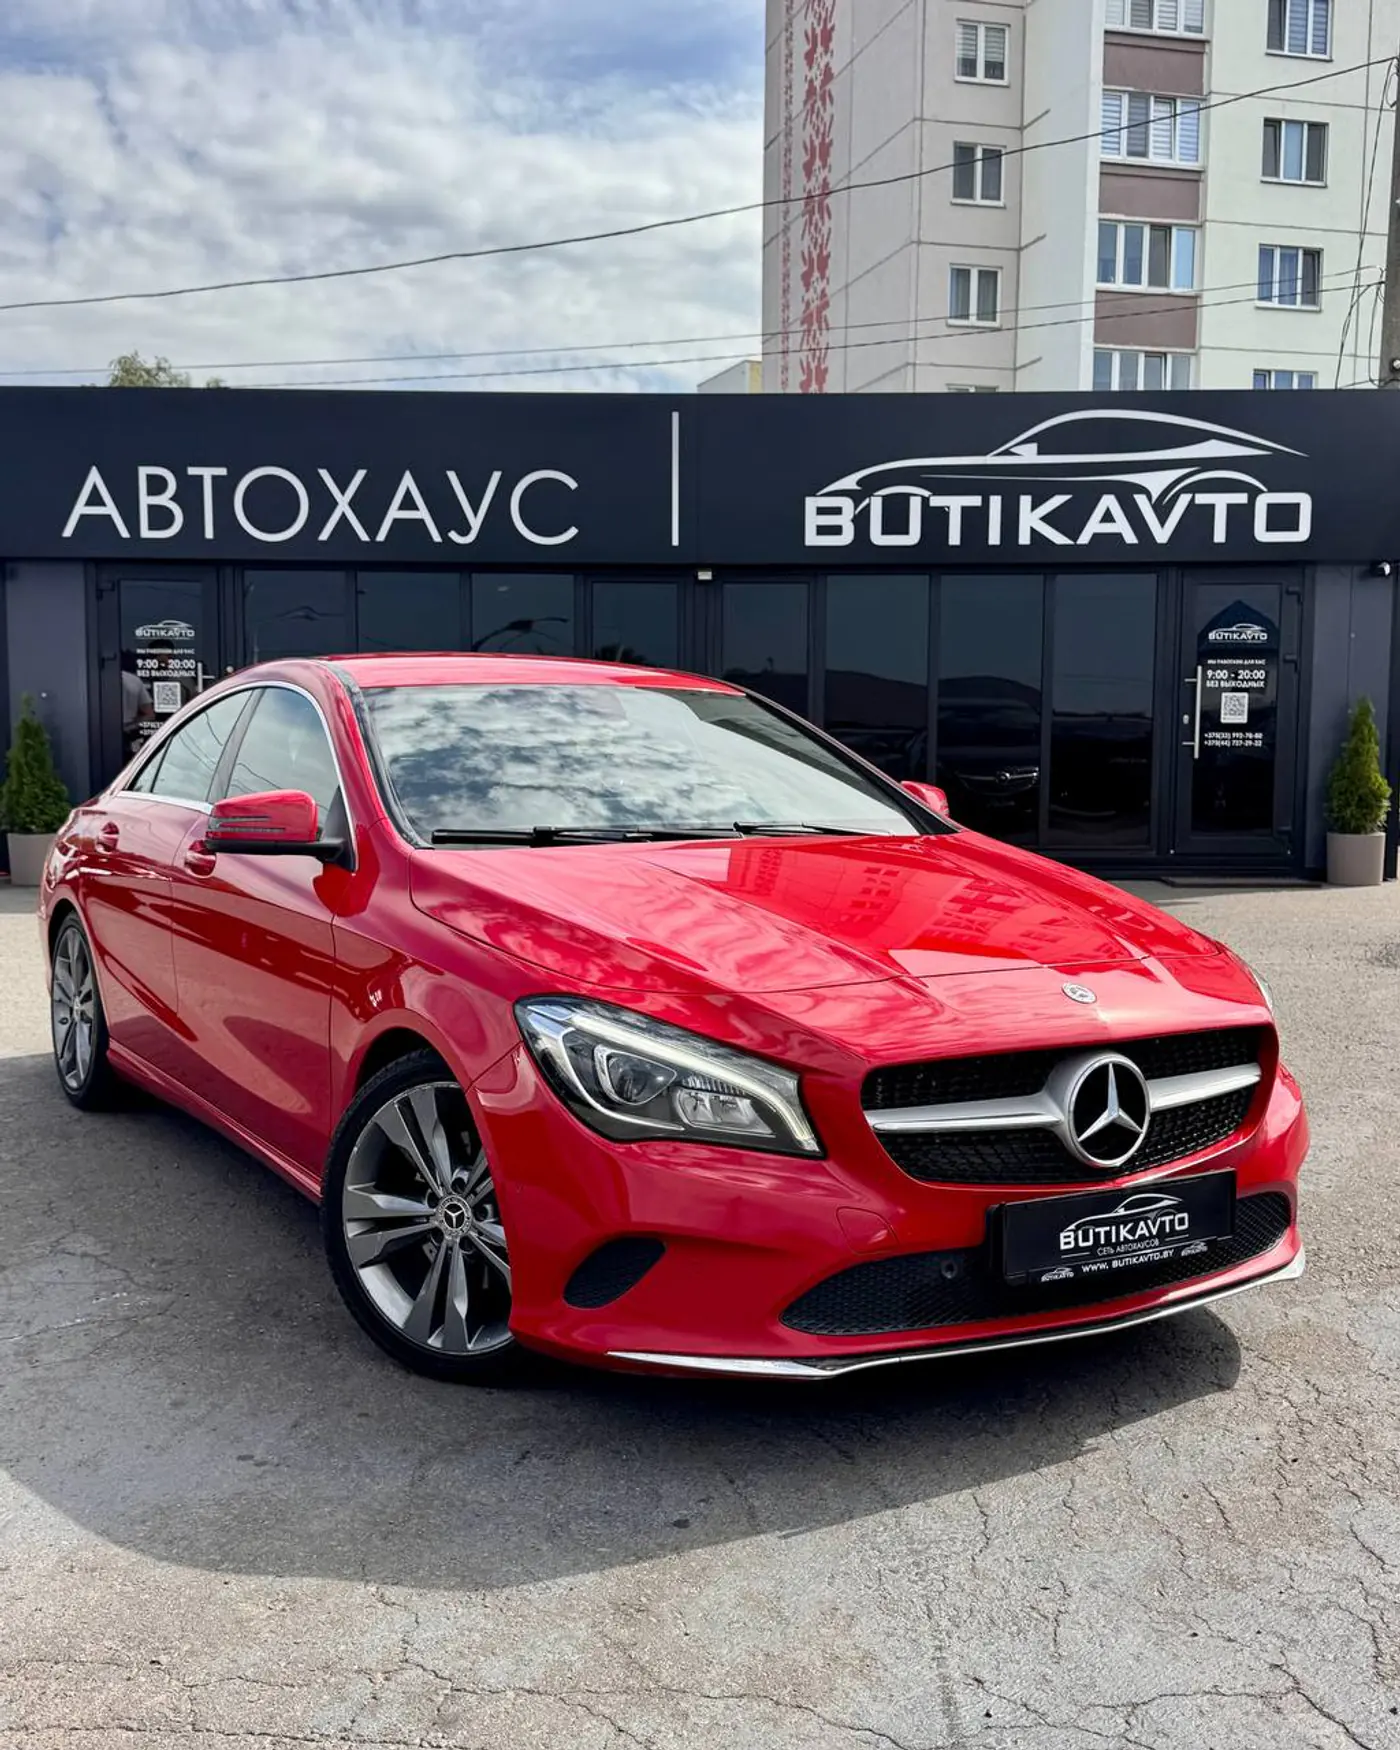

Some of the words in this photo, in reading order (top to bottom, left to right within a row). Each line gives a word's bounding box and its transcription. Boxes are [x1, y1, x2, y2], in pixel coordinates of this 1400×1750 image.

[62, 465, 579, 545] АВТОХАУС
[804, 492, 1311, 547] BUTIKAVTO
[1208, 631, 1268, 640] BUTIKAVTO
[136, 659, 159, 669] 9:00
[167, 659, 196, 669] 20:00
[1207, 669, 1228, 680] 9:00
[1237, 669, 1266, 680] 20:00
[1206, 680, 1219, 688] БЕЗ
[1219, 680, 1265, 688] ВЫХОДНЫХ
[1059, 1212, 1190, 1250] BUTIKAVTO
[1096, 1246, 1115, 1256] СЕТЬ
[1115, 1238, 1160, 1254] АВТОХАУСОВ
